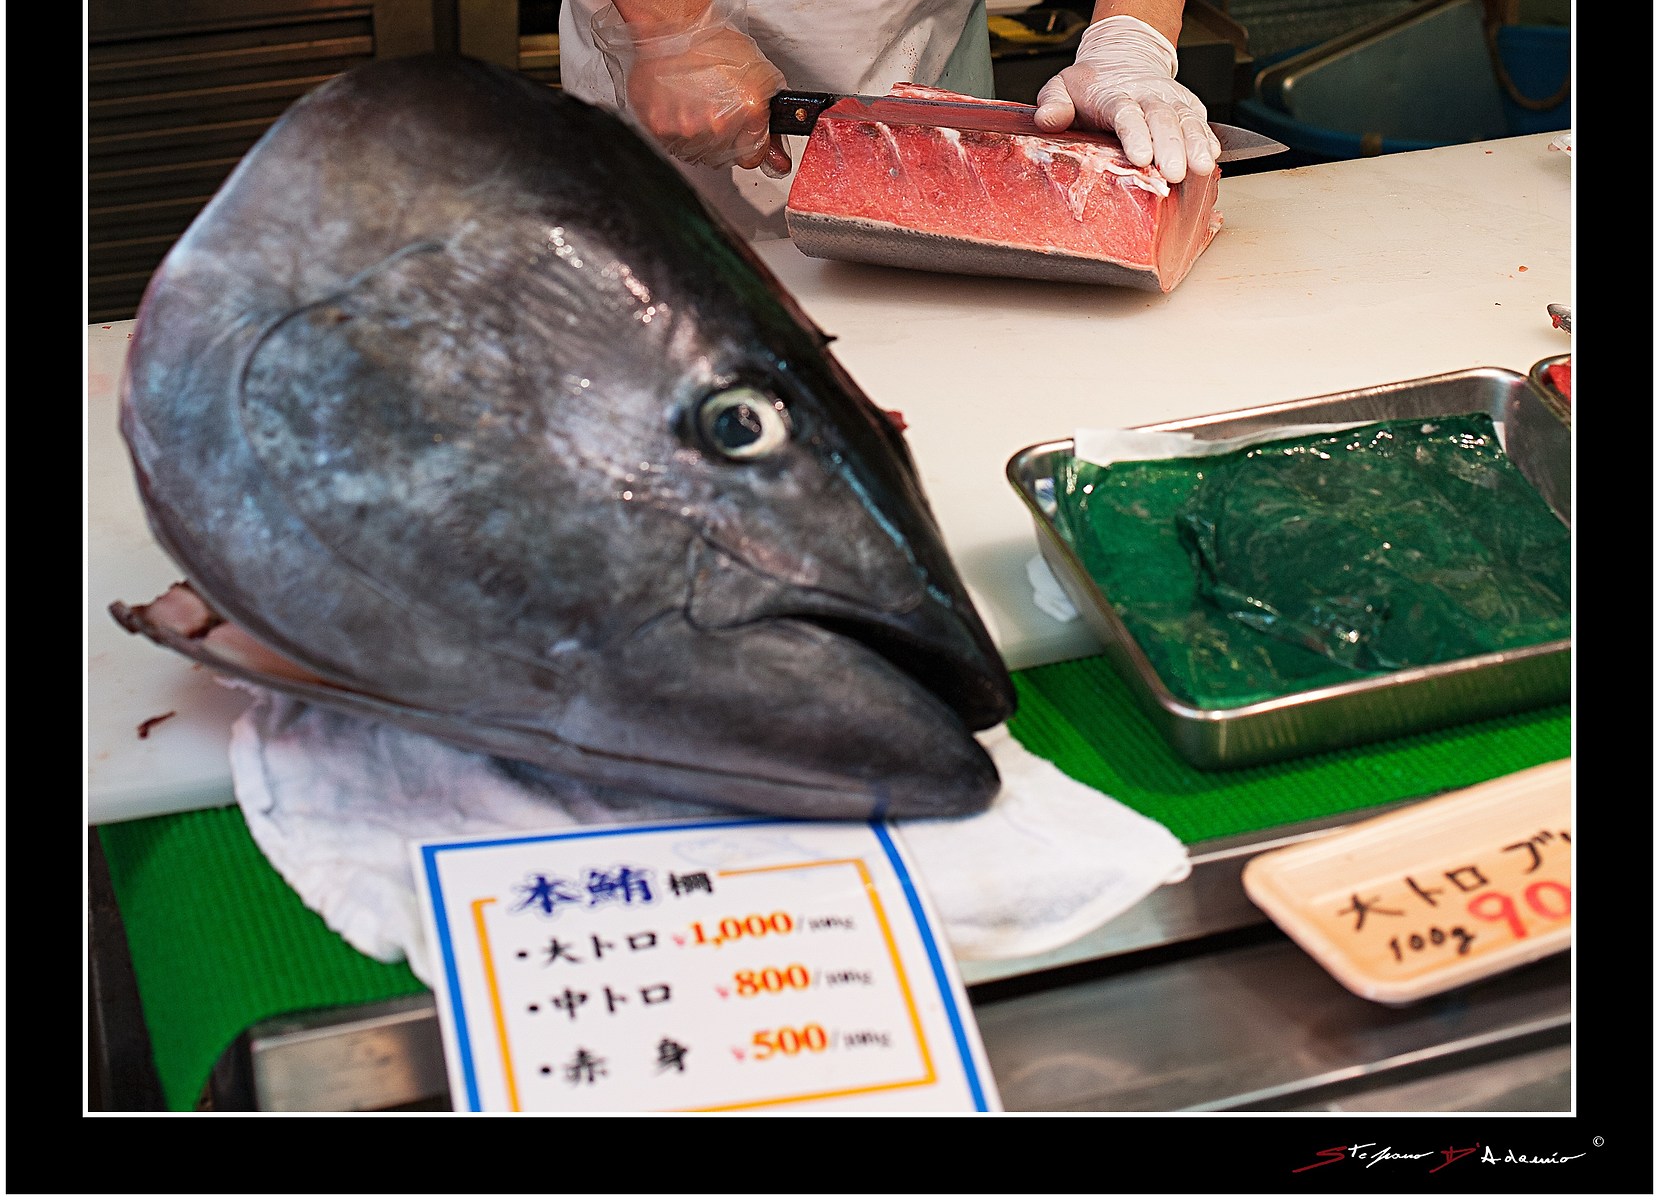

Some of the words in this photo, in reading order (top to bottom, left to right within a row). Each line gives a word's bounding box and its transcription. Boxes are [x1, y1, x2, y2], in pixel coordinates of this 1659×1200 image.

[1337, 865, 1489, 931] 大トロ
[543, 931, 658, 968] 大トロ
[552, 983, 671, 1019] 中トロ
